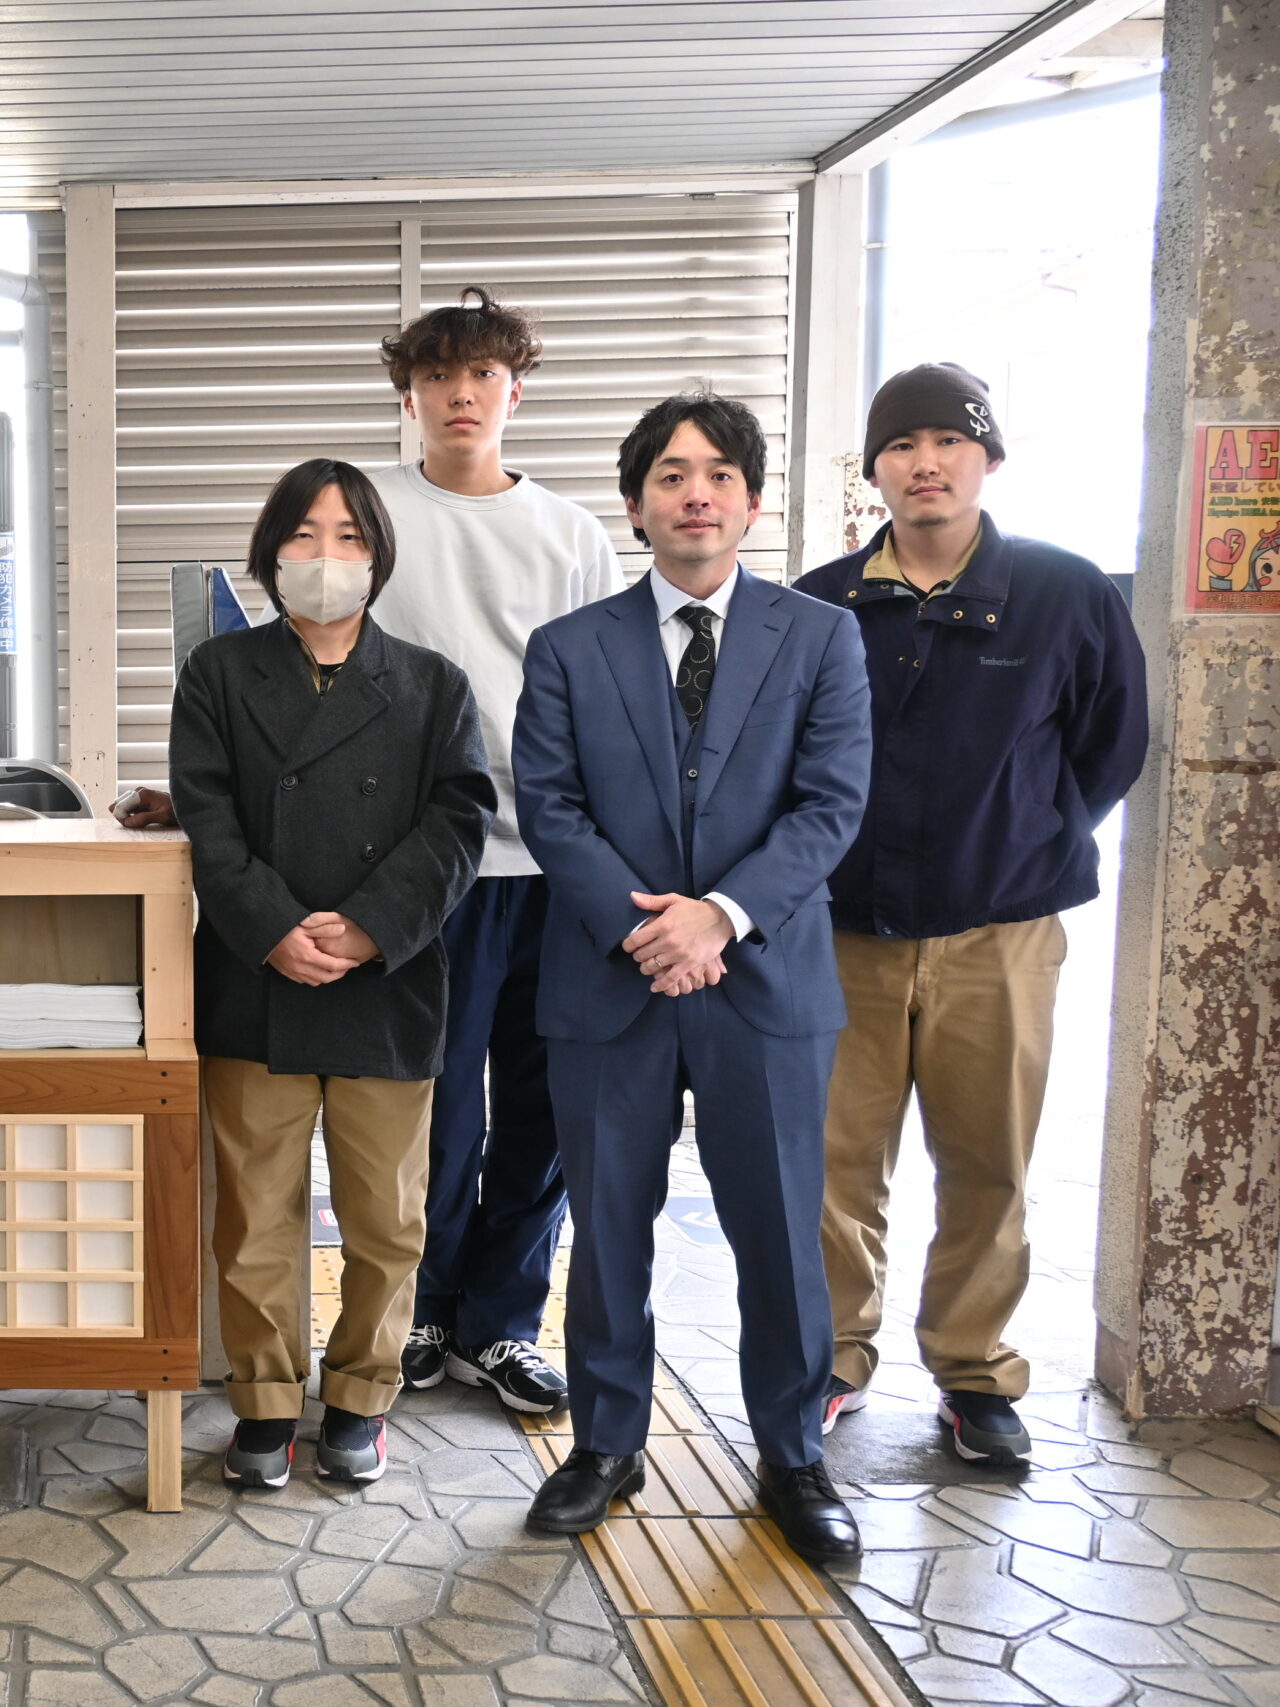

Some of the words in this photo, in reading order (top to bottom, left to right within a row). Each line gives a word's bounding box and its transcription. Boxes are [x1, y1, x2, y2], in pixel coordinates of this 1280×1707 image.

[0, 562, 14, 650] 防犯カメラ作動中
